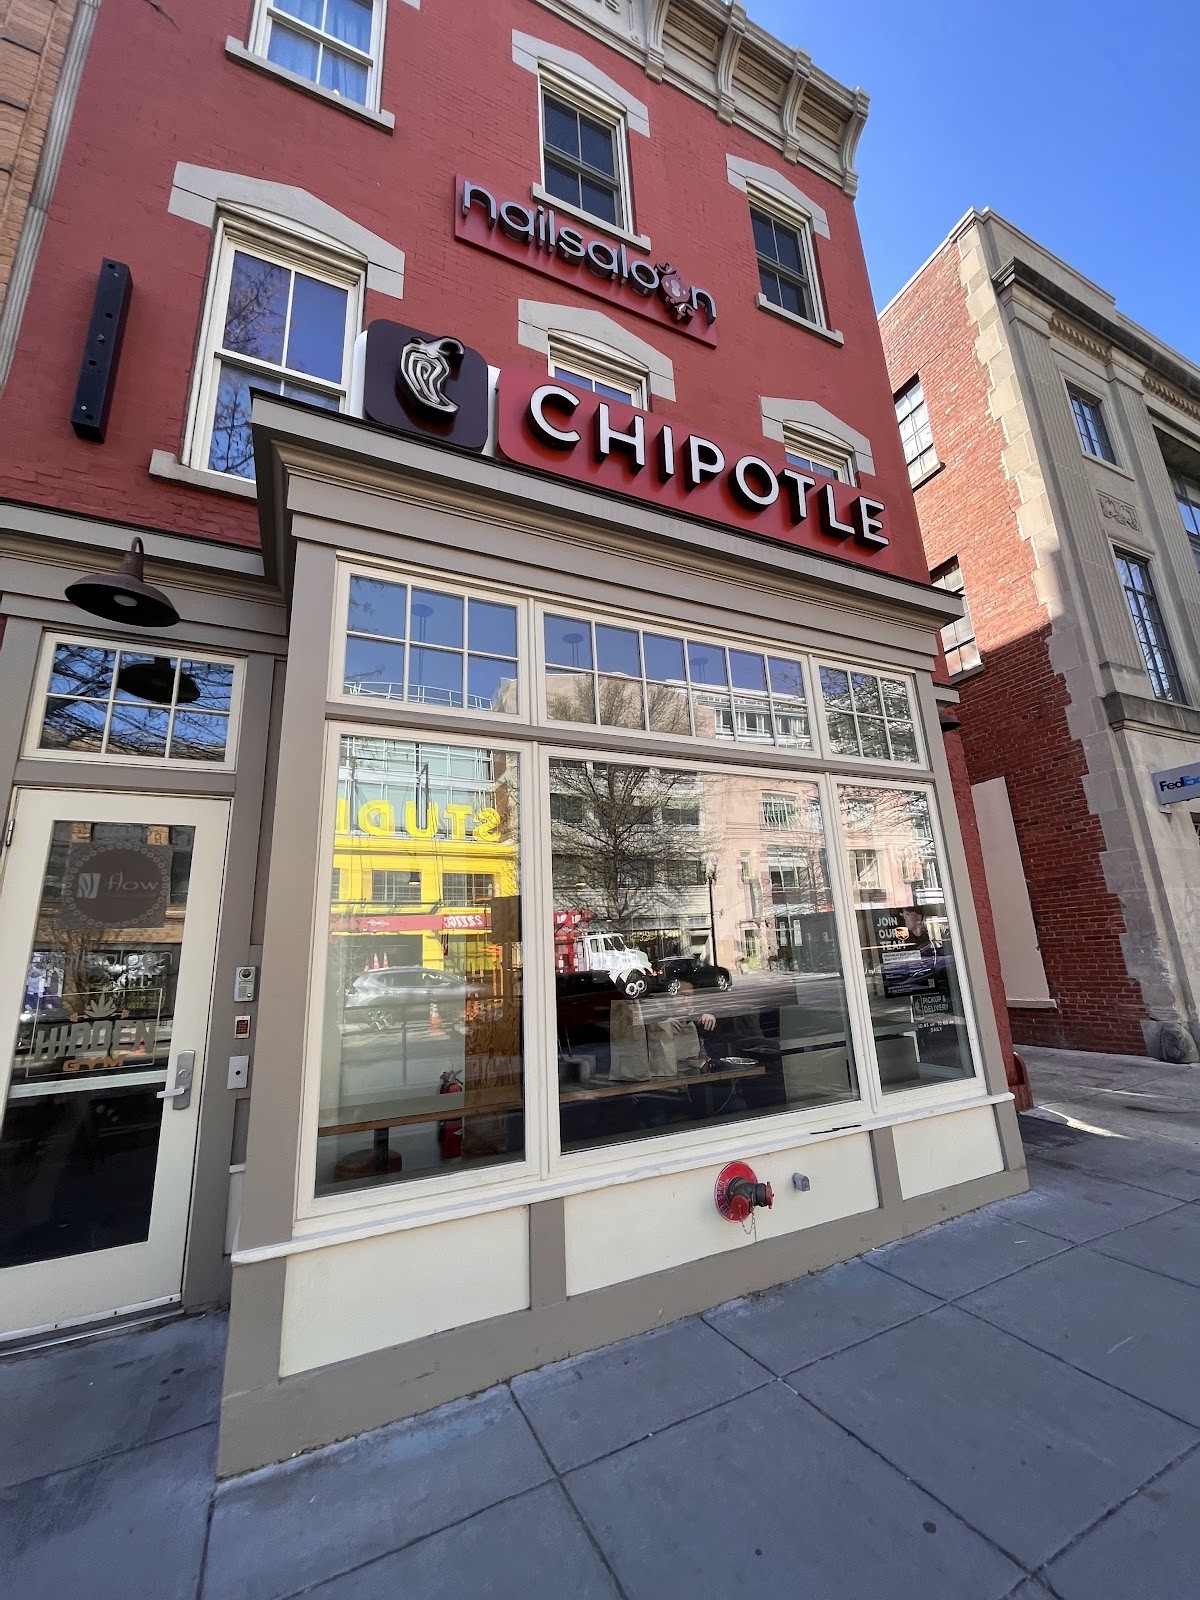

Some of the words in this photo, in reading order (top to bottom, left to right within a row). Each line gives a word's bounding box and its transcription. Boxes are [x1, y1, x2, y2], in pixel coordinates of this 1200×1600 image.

[527, 383, 890, 550] CHIPOTLE
[107, 871, 159, 891] flow
[877, 917, 898, 927] JOIN
[922, 995, 942, 1004] PICKUP
[924, 1003, 949, 1013] DELIVERY
[33, 1019, 157, 1063] HIDDEN
[62, 1054, 126, 1072] GYM
